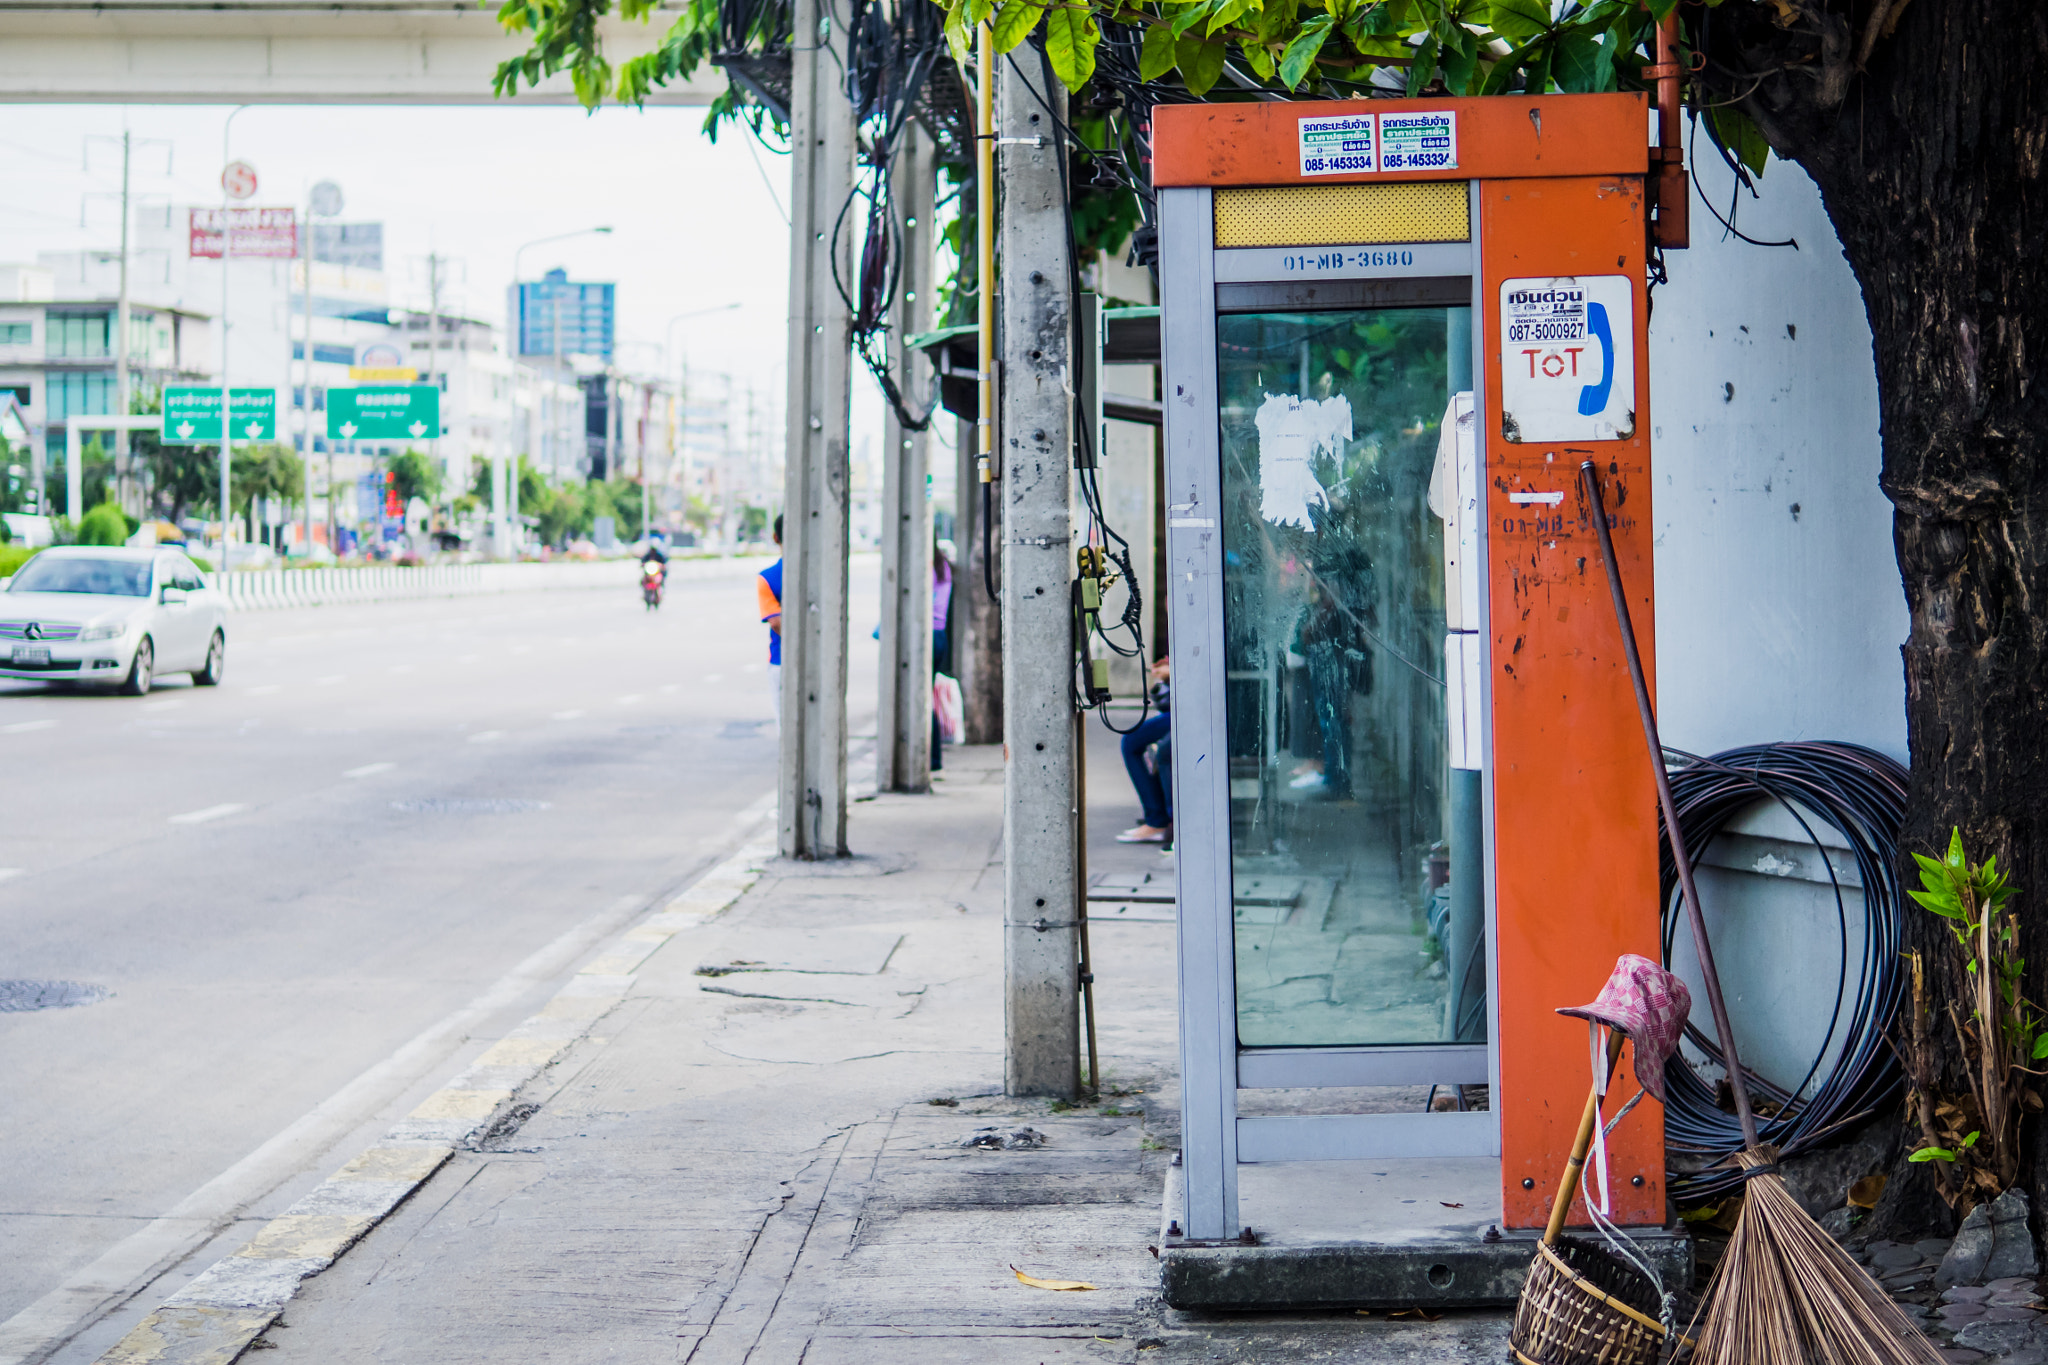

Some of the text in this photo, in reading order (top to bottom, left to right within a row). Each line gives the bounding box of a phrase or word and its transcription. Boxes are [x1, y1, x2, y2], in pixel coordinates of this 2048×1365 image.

[1303, 119, 1370, 132] รถกระบะรับจ้าง
[1382, 115, 1449, 128] รถกระบะรับจ้าง
[1305, 156, 1371, 171] 085-1453334
[1284, 250, 1413, 271] 01-MB-3680
[1509, 289, 1582, 303] เงินด่วน
[1509, 322, 1584, 341] 087-5000927
[1521, 347, 1585, 379] TOT
